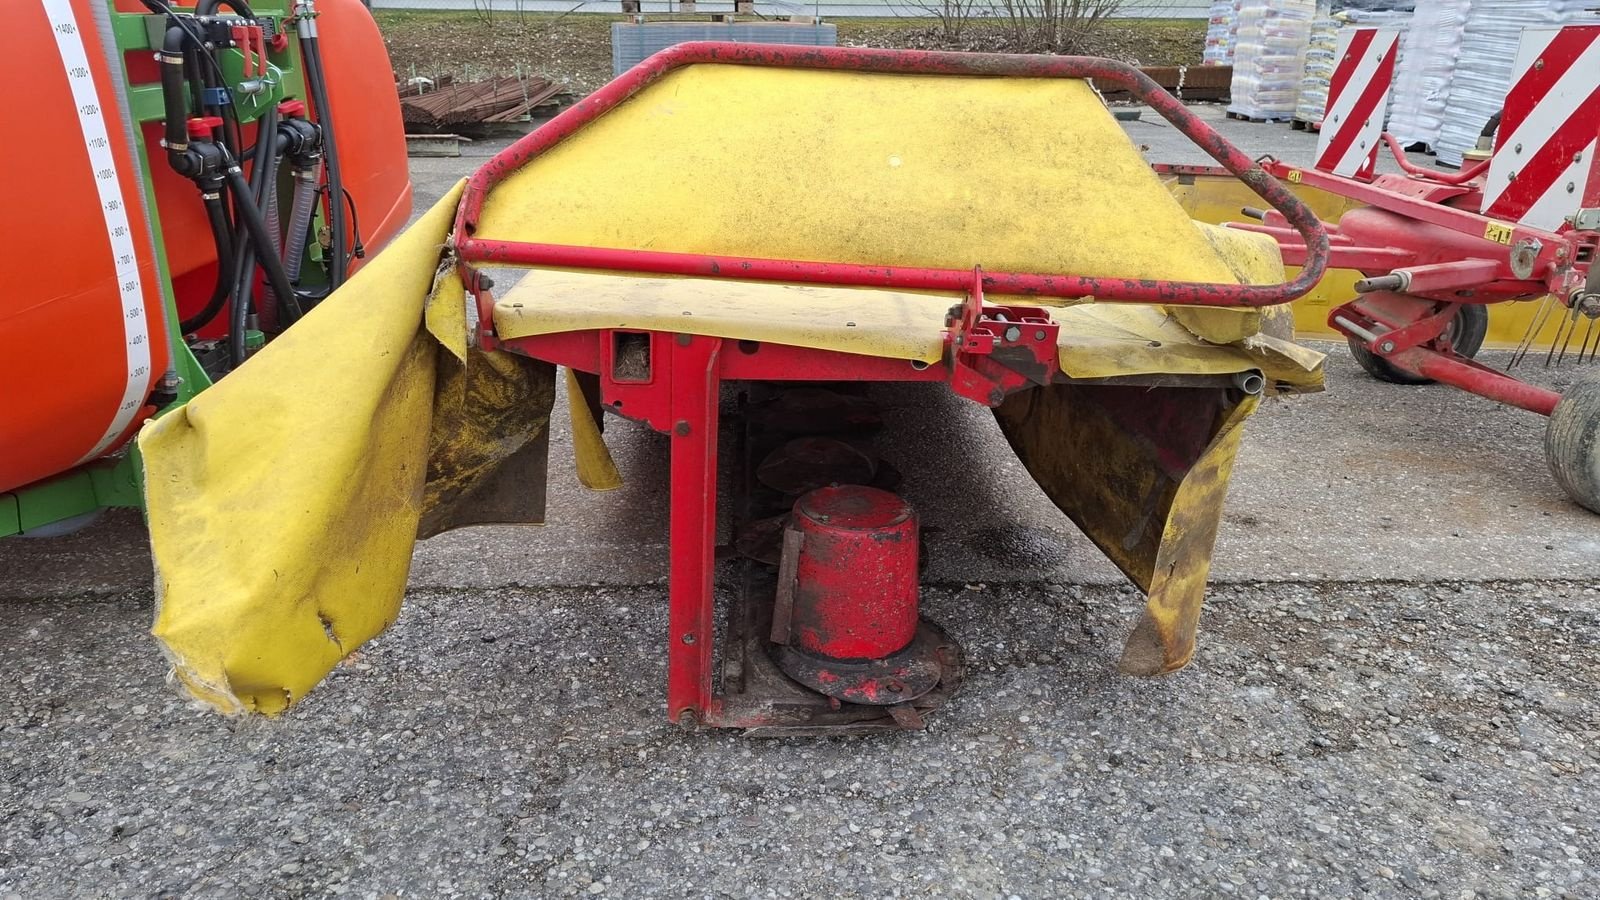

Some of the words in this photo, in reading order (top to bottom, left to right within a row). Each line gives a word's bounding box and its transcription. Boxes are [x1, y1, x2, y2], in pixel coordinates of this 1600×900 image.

[58, 24, 73, 34] 1400
[99, 168, 112, 179] 1000
[121, 255, 131, 265] 700
[132, 335, 142, 346] 400
